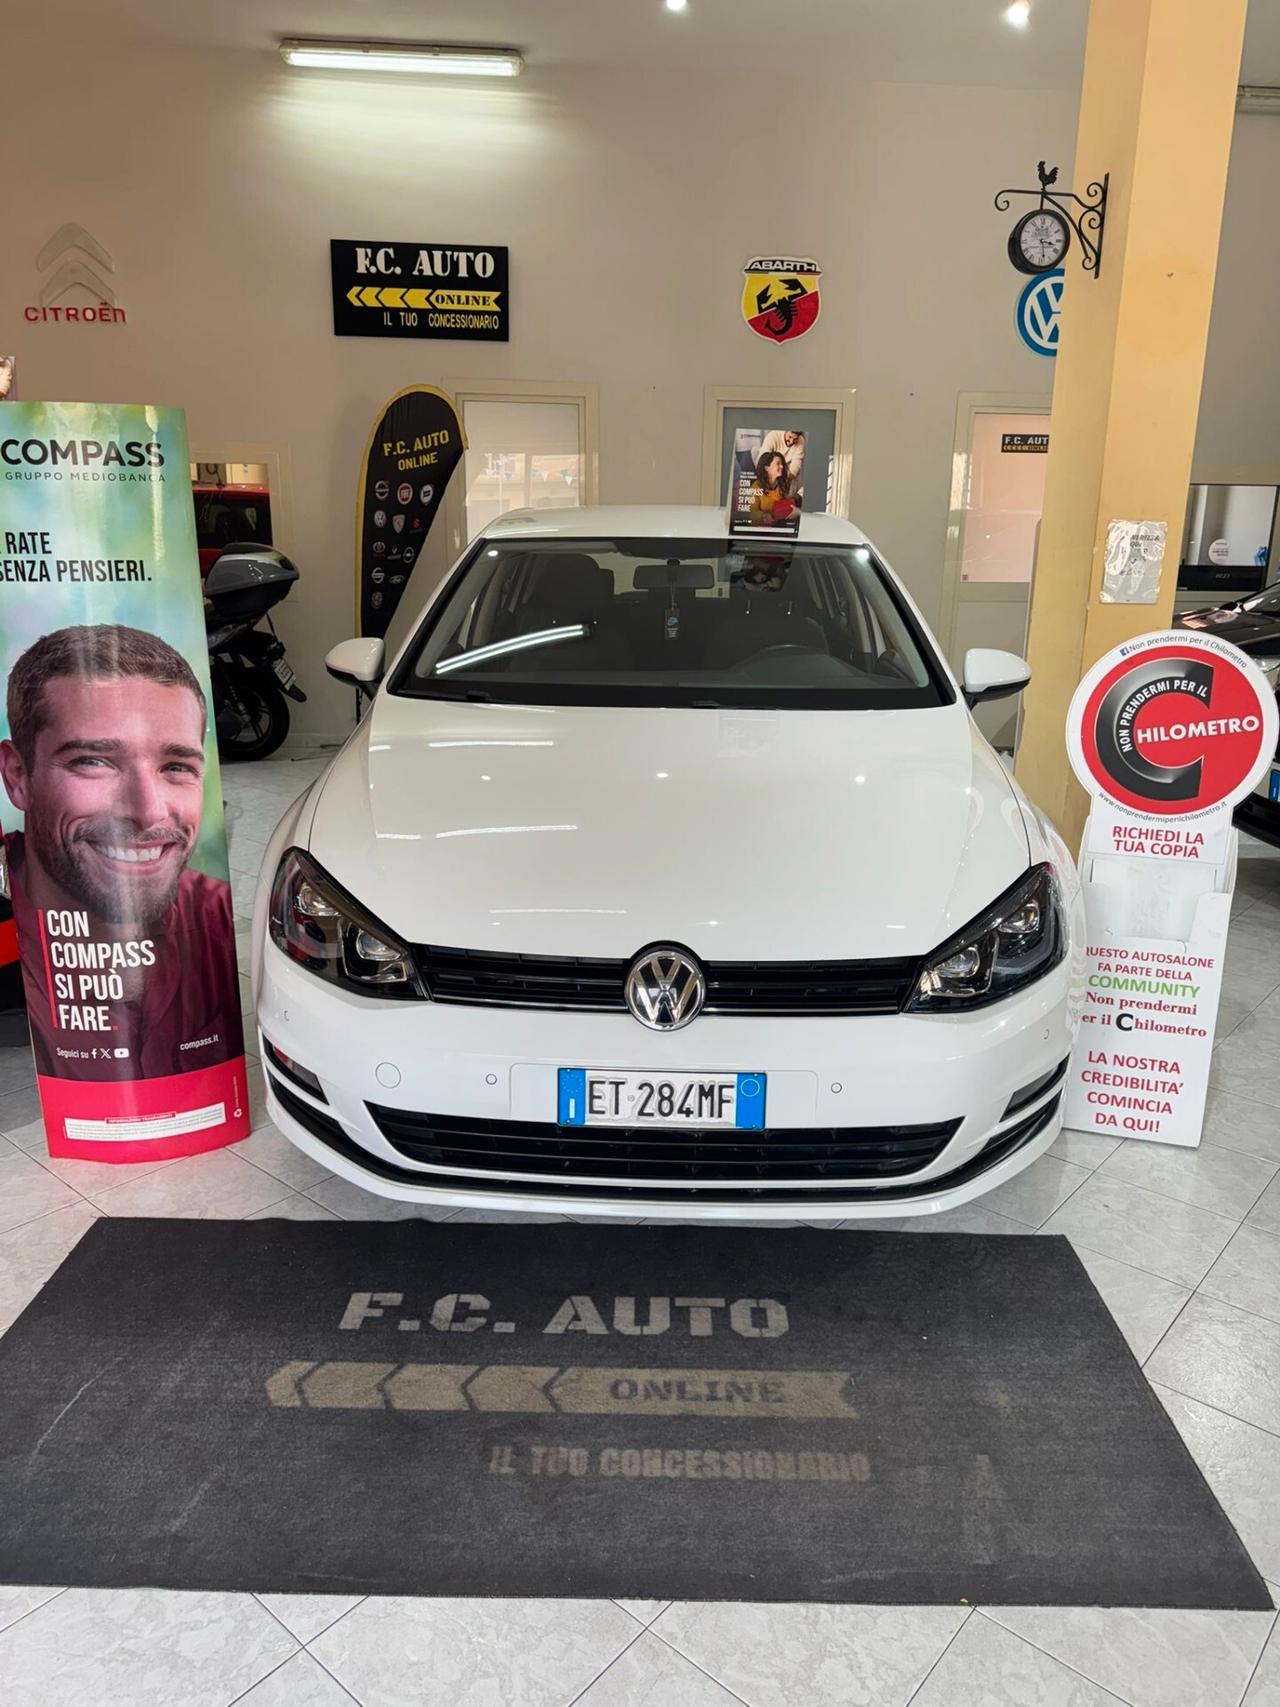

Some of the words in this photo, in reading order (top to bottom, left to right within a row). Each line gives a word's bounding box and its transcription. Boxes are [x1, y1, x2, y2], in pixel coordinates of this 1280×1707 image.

[356, 247, 402, 275] F.C.
[412, 250, 494, 278] AUTO
[750, 260, 817, 271] ABARTH
[435, 294, 491, 307] ONLINE
[384, 312, 393, 326] IL
[400, 312, 418, 327] TUO
[428, 314, 499, 330] CONCESSIONARIO
[384, 441, 410, 456] F.C.
[413, 430, 450, 451] AUTO
[1005, 436, 1024, 445] F.C.
[1027, 436, 1049, 445] AUT
[0, 439, 165, 468] COMPASS
[398, 452, 439, 471] ONLINE
[5, 471, 63, 482] GRUPPO
[70, 472, 166, 483] MEDIOBANCA
[5, 531, 52, 555] RATE
[56, 559, 153, 582] PENSIERI.
[1129, 641, 1145, 653] Non
[1147, 635, 1188, 648] prendermi
[1189, 636, 1203, 648] per
[1210, 641, 1248, 669] Chilometro
[1173, 679, 1196, 692] PER
[1197, 683, 1208, 698] IL
[1120, 680, 1170, 727] PRENDERMI
[1118, 729, 1133, 753] NON
[1112, 826, 1180, 842] RICHIEDI
[1186, 832, 1204, 845] LA
[1114, 840, 1145, 853] TUA
[1151, 843, 1199, 858] COPIA
[47, 909, 90, 937] CON
[50, 940, 156, 969] COMPASS
[1131, 951, 1214, 968] AUTOSALONE
[1097, 962, 1111, 972] FA
[1115, 964, 1152, 977] PARTE
[1155, 968, 1192, 981] DELLA
[54, 973, 75, 1000] SI
[80, 967, 124, 1001] PUÒ
[1088, 974, 1200, 998] COMMUNITY
[1086, 992, 1114, 1005] Non
[1119, 998, 1197, 1015] prendermi
[58, 1004, 118, 1032] FARE.
[1082, 1013, 1097, 1024] er
[1101, 1014, 1112, 1026] il
[1115, 1013, 1207, 1038] Chilometro
[56, 1047, 79, 1059] Seguici
[80, 1050, 89, 1059] su
[179, 1034, 219, 1051] compass.it
[1088, 1051, 1107, 1067] LA
[1113, 1054, 1181, 1074] NOSTRA
[1081, 1070, 1184, 1095] CREDIBILITA'
[588, 1080, 626, 1116] ET
[637, 1082, 735, 1119] 284MF
[1087, 1091, 1173, 1114] COMINCIA
[1095, 1112, 1118, 1126] DA
[1123, 1115, 1160, 1133] QUI!
[337, 1292, 517, 1333] F.C.
[541, 1294, 790, 1338] AUTO
[609, 1378, 786, 1404] ONLINE
[488, 1446, 517, 1476] IL
[530, 1446, 590, 1477] TUO
[598, 1447, 873, 1481] CONCESSIONARIO
